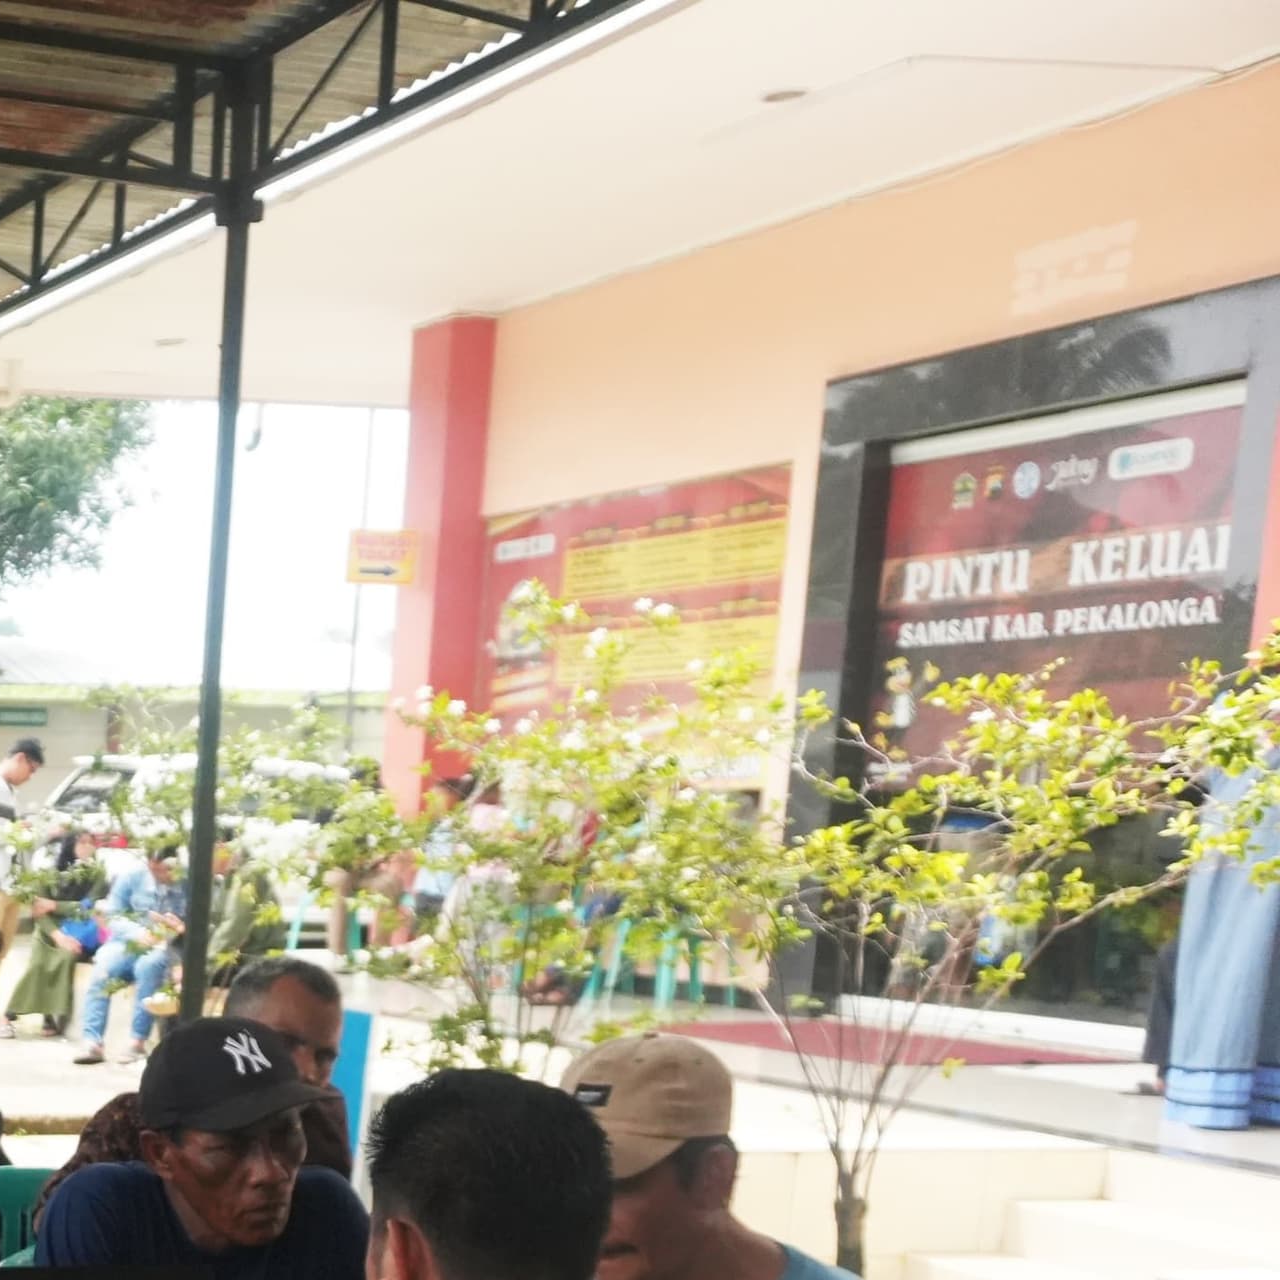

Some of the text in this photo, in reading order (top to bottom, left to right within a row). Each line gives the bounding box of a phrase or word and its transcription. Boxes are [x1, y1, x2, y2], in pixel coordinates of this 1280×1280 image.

[901, 549, 1031, 604] PINTU
[897, 594, 1224, 648] SAMSAT KAB. PEKALONGA
[222, 1029, 272, 1075] NY
